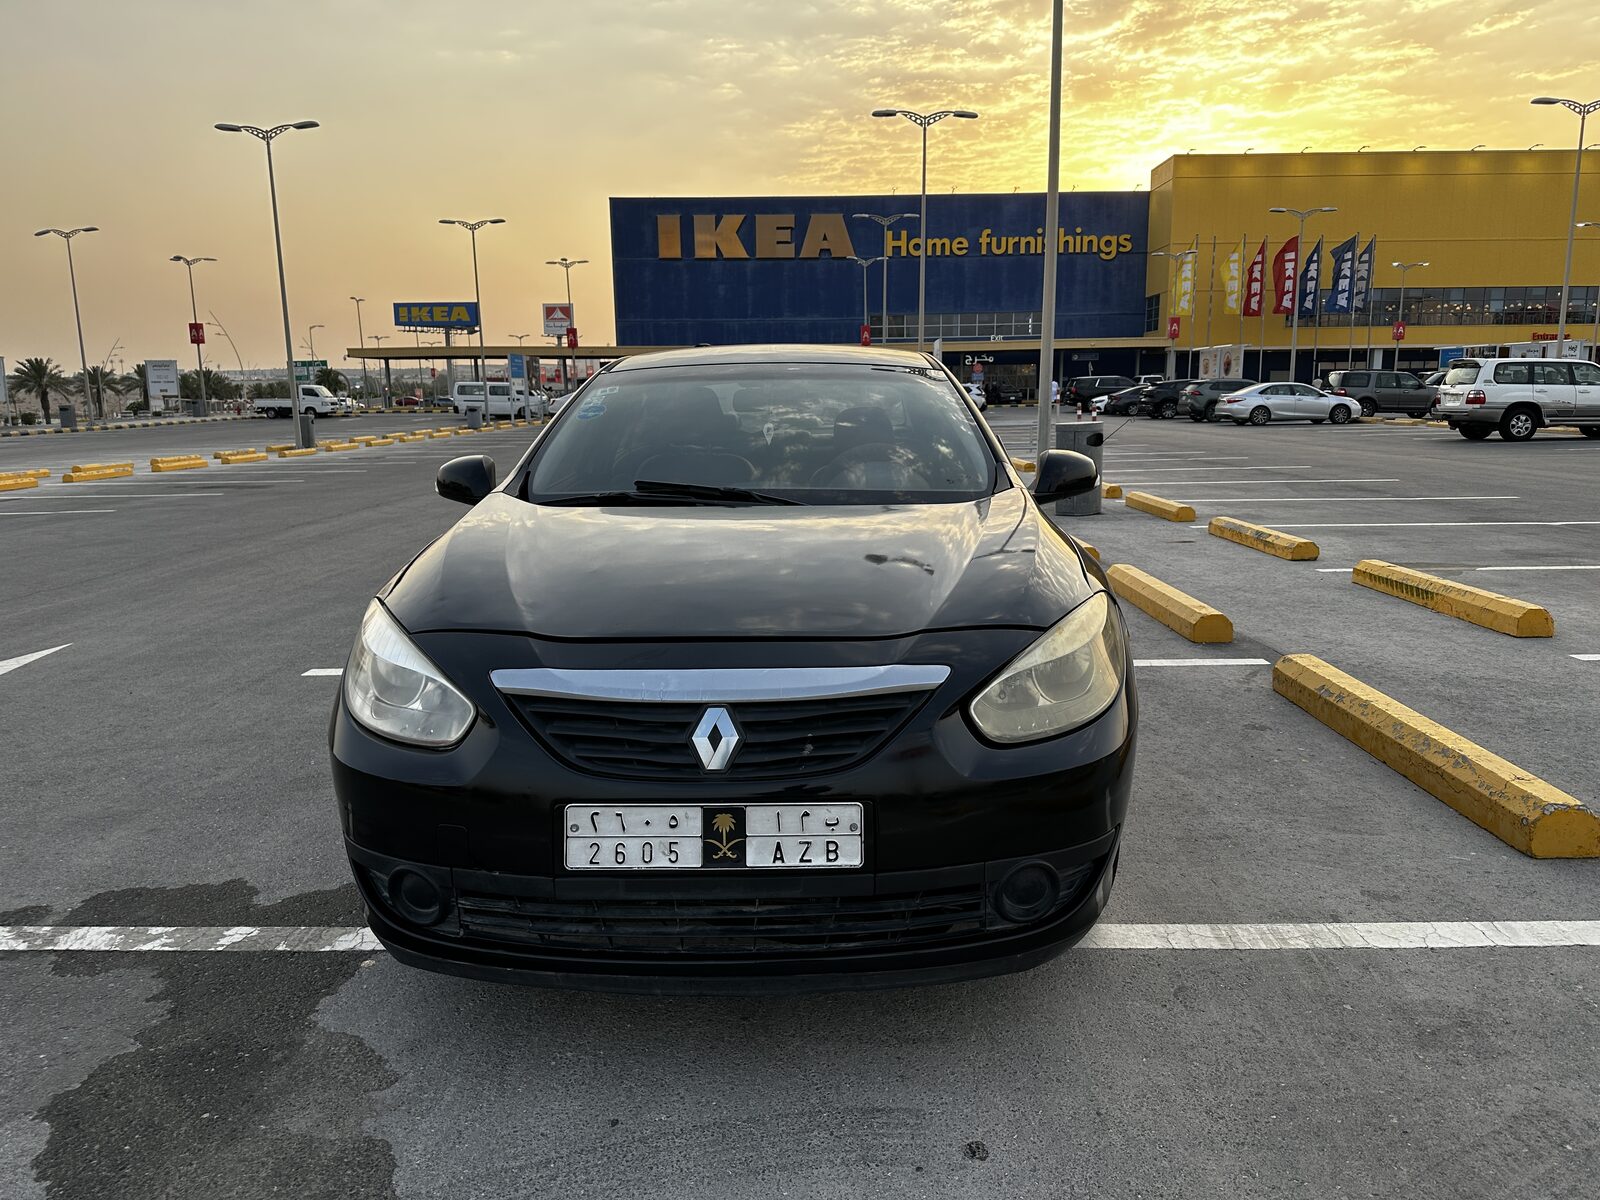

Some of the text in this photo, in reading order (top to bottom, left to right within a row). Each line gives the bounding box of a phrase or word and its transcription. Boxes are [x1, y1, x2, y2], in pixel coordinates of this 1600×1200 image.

[656, 213, 856, 260] IKEA
[886, 227, 1133, 260] Home furnihings
[1180, 254, 1192, 310] IKEA
[1227, 253, 1239, 309] IKEA
[1250, 254, 1262, 311] IKEA
[1281, 251, 1296, 309] IKEA
[1303, 252, 1318, 310] IKEA
[1336, 251, 1352, 308] IKEA
[1354, 253, 1369, 309] IKEA
[398, 306, 471, 322] IKEA
[965, 353, 994, 365] مخرج
[588, 840, 839, 865] 2605 AZB
